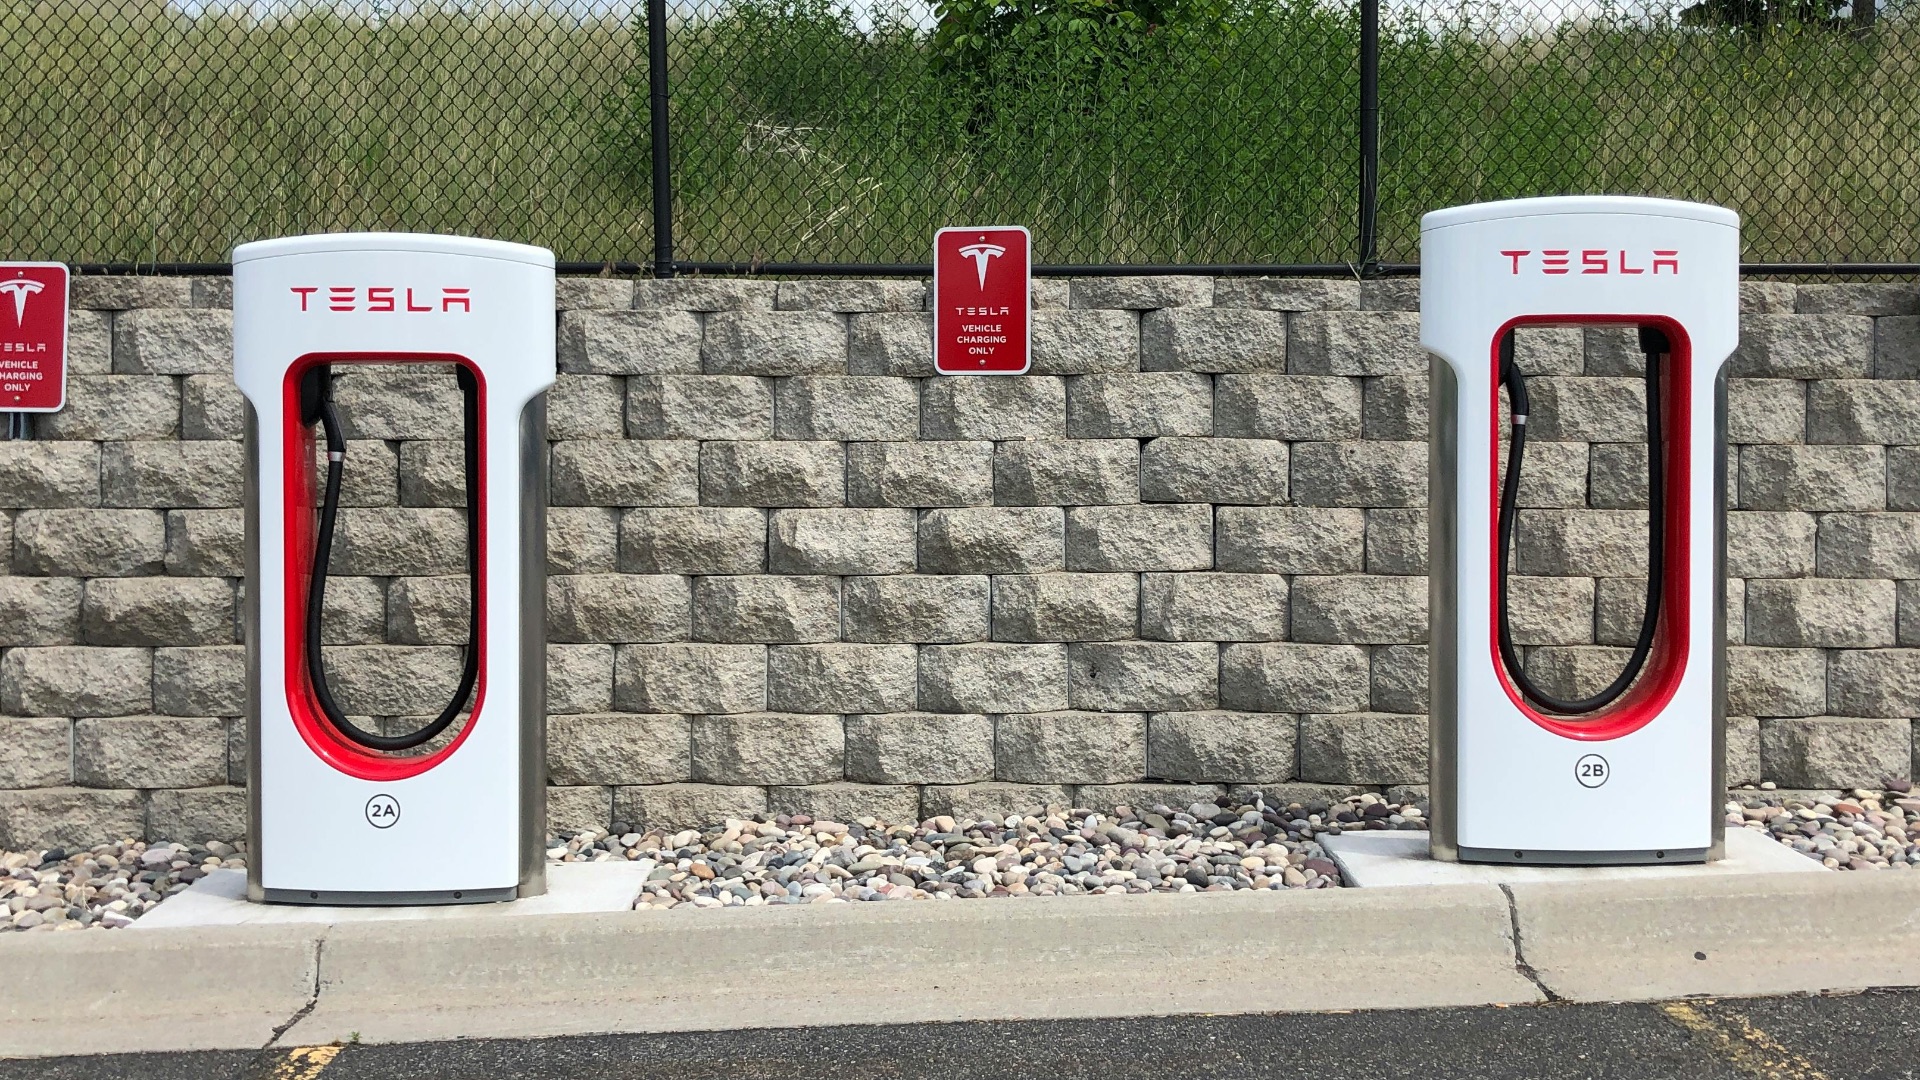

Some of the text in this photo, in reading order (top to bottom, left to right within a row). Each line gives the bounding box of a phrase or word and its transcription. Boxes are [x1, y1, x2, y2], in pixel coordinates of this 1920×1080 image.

[1500, 250, 1678, 274] TESLA
[290, 287, 470, 312] TESLA
[955, 306, 1009, 316] TESLA
[961, 324, 1002, 333] VEHICLE
[956, 335, 1007, 344] CHARGING
[0, 342, 46, 352] ESLA
[968, 346, 995, 355] ONLY
[0, 360, 39, 369] VEHICLE
[0, 371, 43, 380] HARGING
[4, 383, 31, 391] ONLY
[1581, 763, 1604, 777] 2B
[371, 804, 396, 817] 2A
